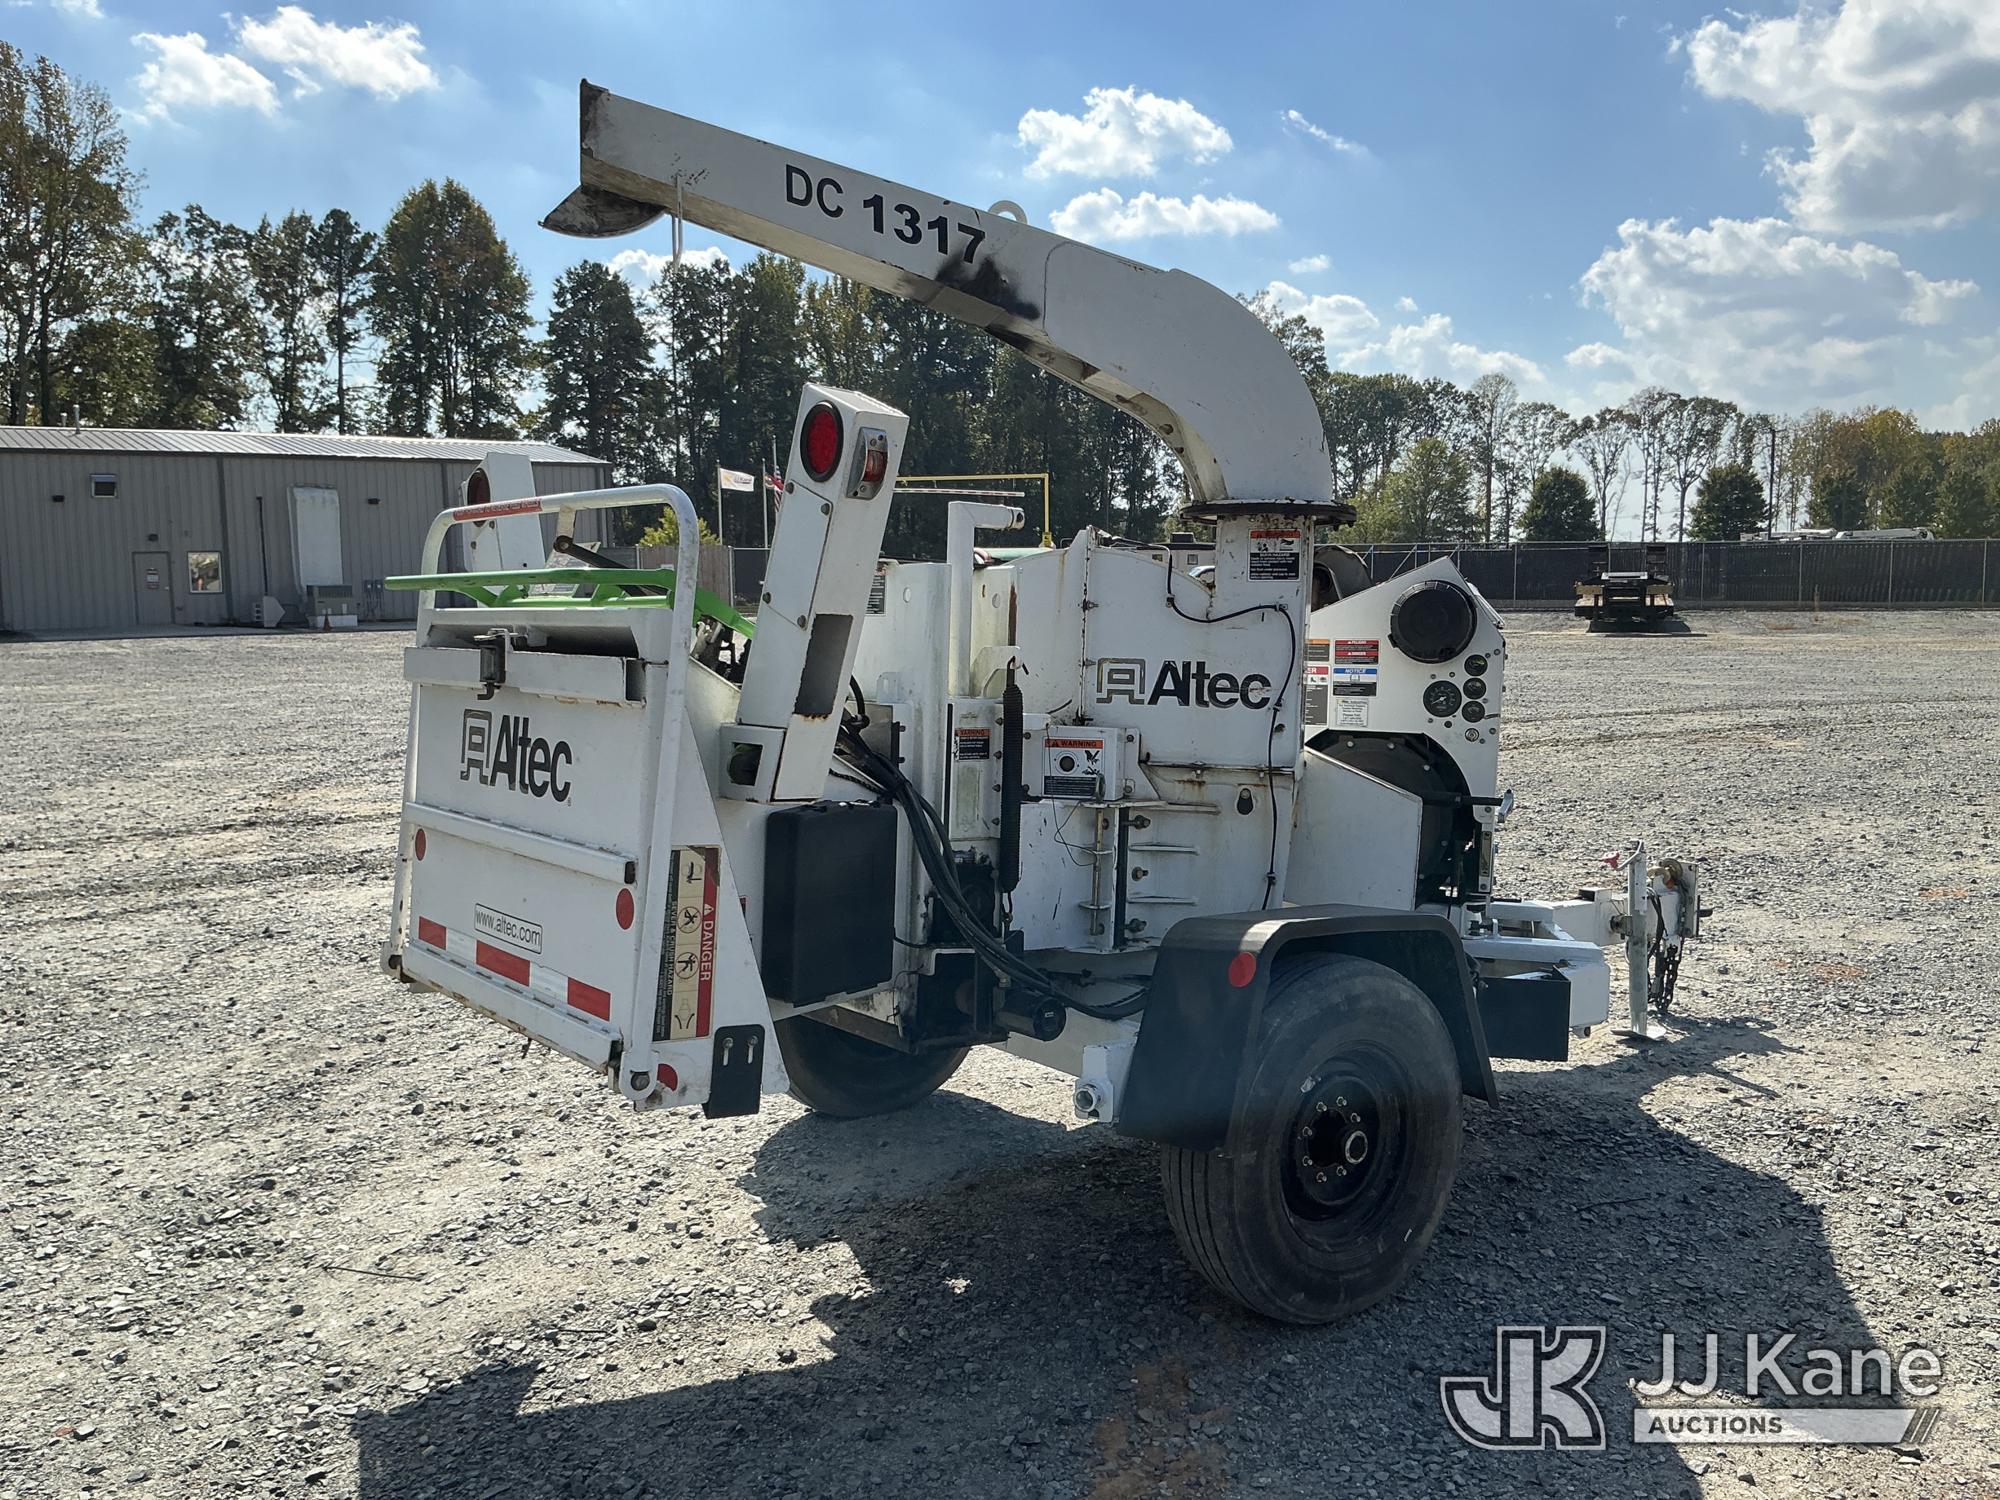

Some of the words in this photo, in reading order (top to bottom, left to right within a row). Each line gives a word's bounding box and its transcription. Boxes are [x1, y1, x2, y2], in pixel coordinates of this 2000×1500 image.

[785, 163, 844, 219] DC
[862, 193, 986, 264] 1317
[1147, 660, 1272, 710] Altec
[489, 714, 573, 803] Altec
[1061, 740, 1098, 748] WARNING
[475, 909, 541, 947] www.altec.com
[700, 920, 714, 981] DANGER
[666, 963, 674, 996] HAZARD
